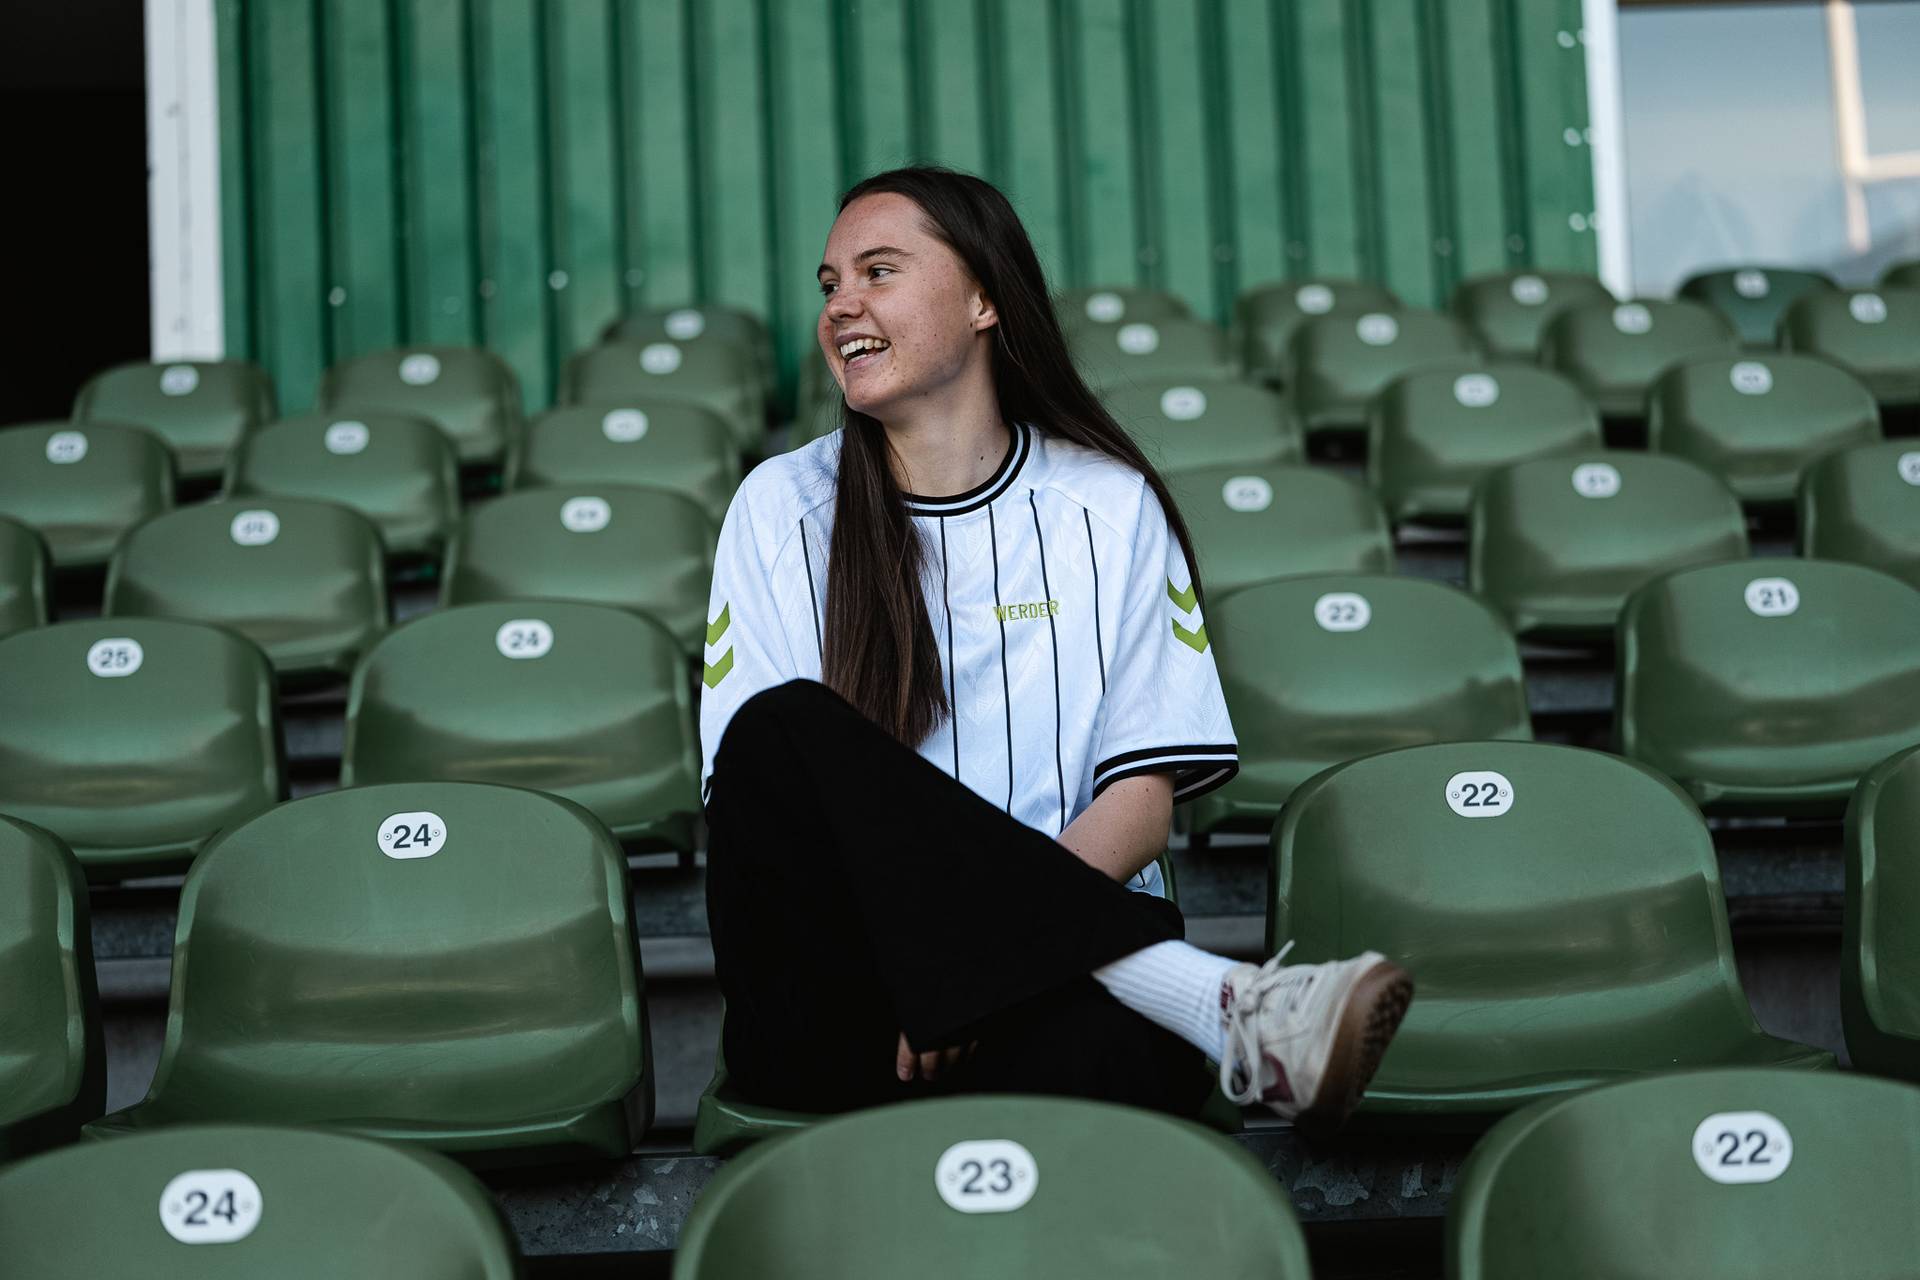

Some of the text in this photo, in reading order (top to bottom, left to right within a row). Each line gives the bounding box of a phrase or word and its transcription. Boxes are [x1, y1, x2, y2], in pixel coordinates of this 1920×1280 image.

[1759, 588, 1788, 608] 21
[994, 599, 1060, 623] WERDER
[1330, 602, 1358, 622] 22
[510, 629, 540, 650] 24
[100, 647, 130, 668] 25
[1461, 782, 1500, 807] 22
[393, 823, 432, 850] 24
[1717, 1130, 1771, 1166] 22
[960, 1158, 1014, 1195] 23
[184, 1190, 238, 1226] 24
